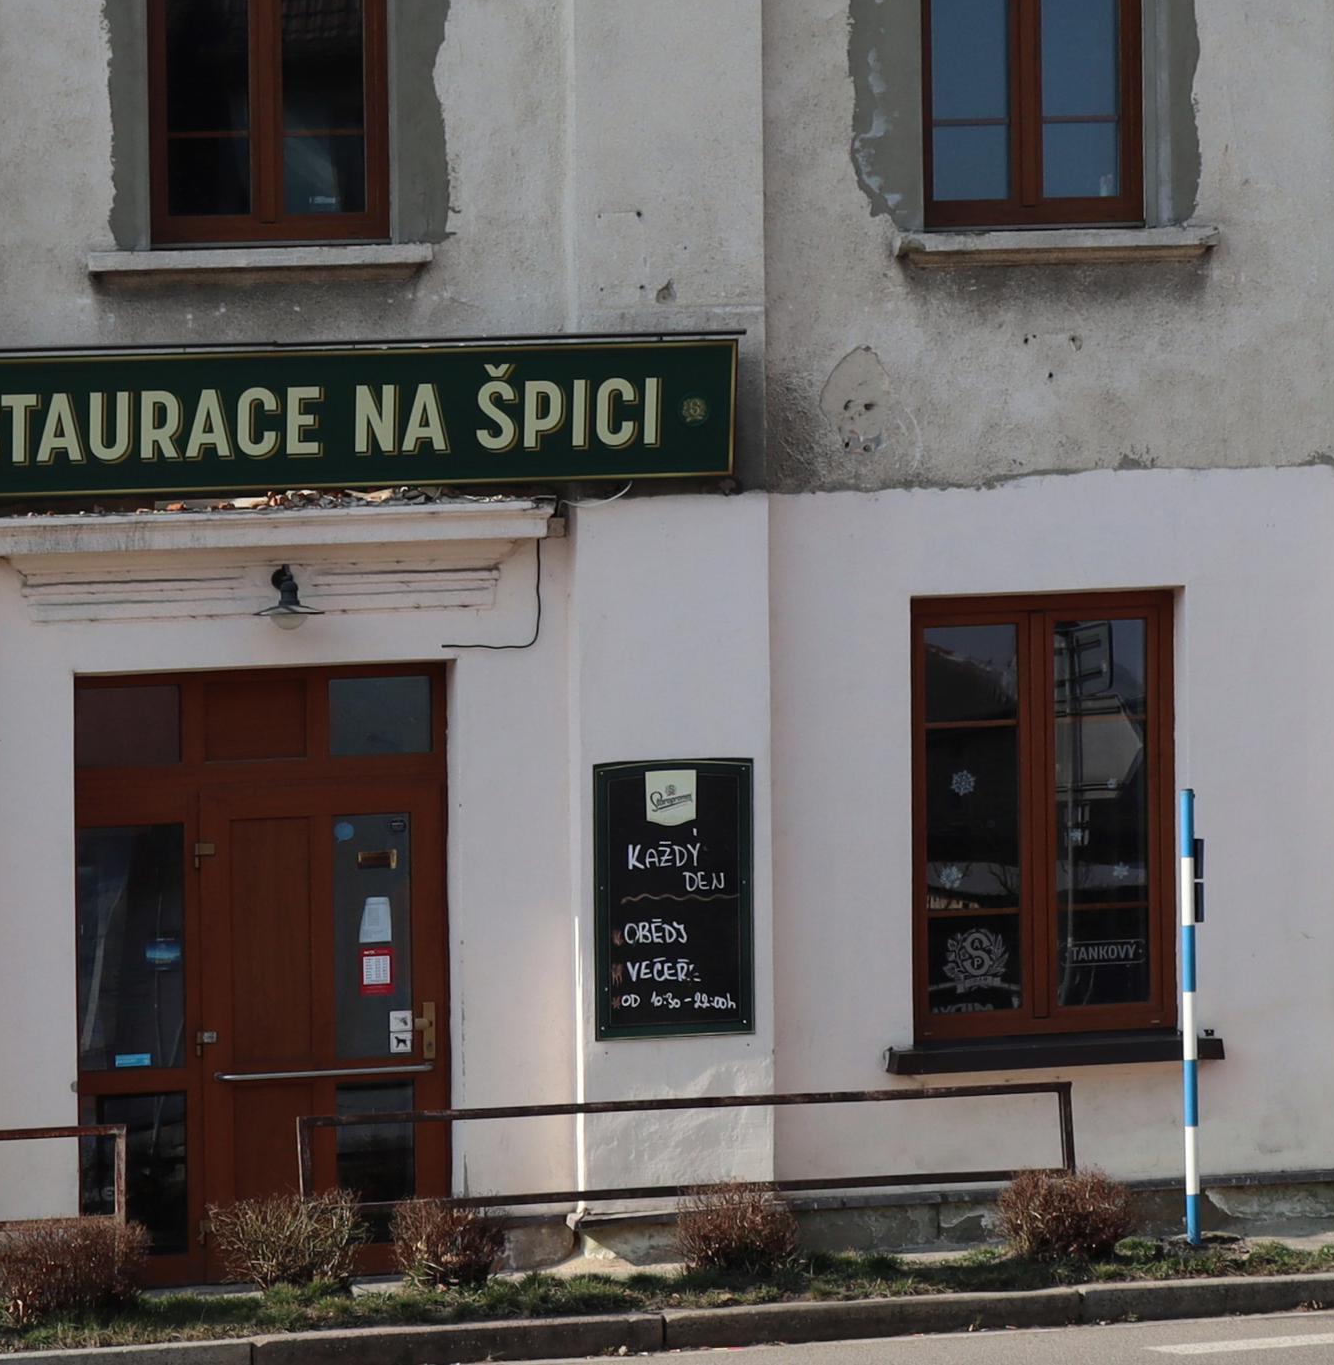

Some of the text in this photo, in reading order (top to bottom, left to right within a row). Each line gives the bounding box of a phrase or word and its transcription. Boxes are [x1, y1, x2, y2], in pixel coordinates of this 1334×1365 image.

[354, 383, 451, 455] NA
[475, 364, 663, 453] ŠPICI
[628, 827, 701, 870] KAŽDÝ
[682, 871, 725, 892] DEN
[624, 918, 688, 944] OBĚDY
[621, 994, 641, 1008] OD
[650, 991, 681, 1010] 10:30
[693, 992, 736, 1010] 22:00h
